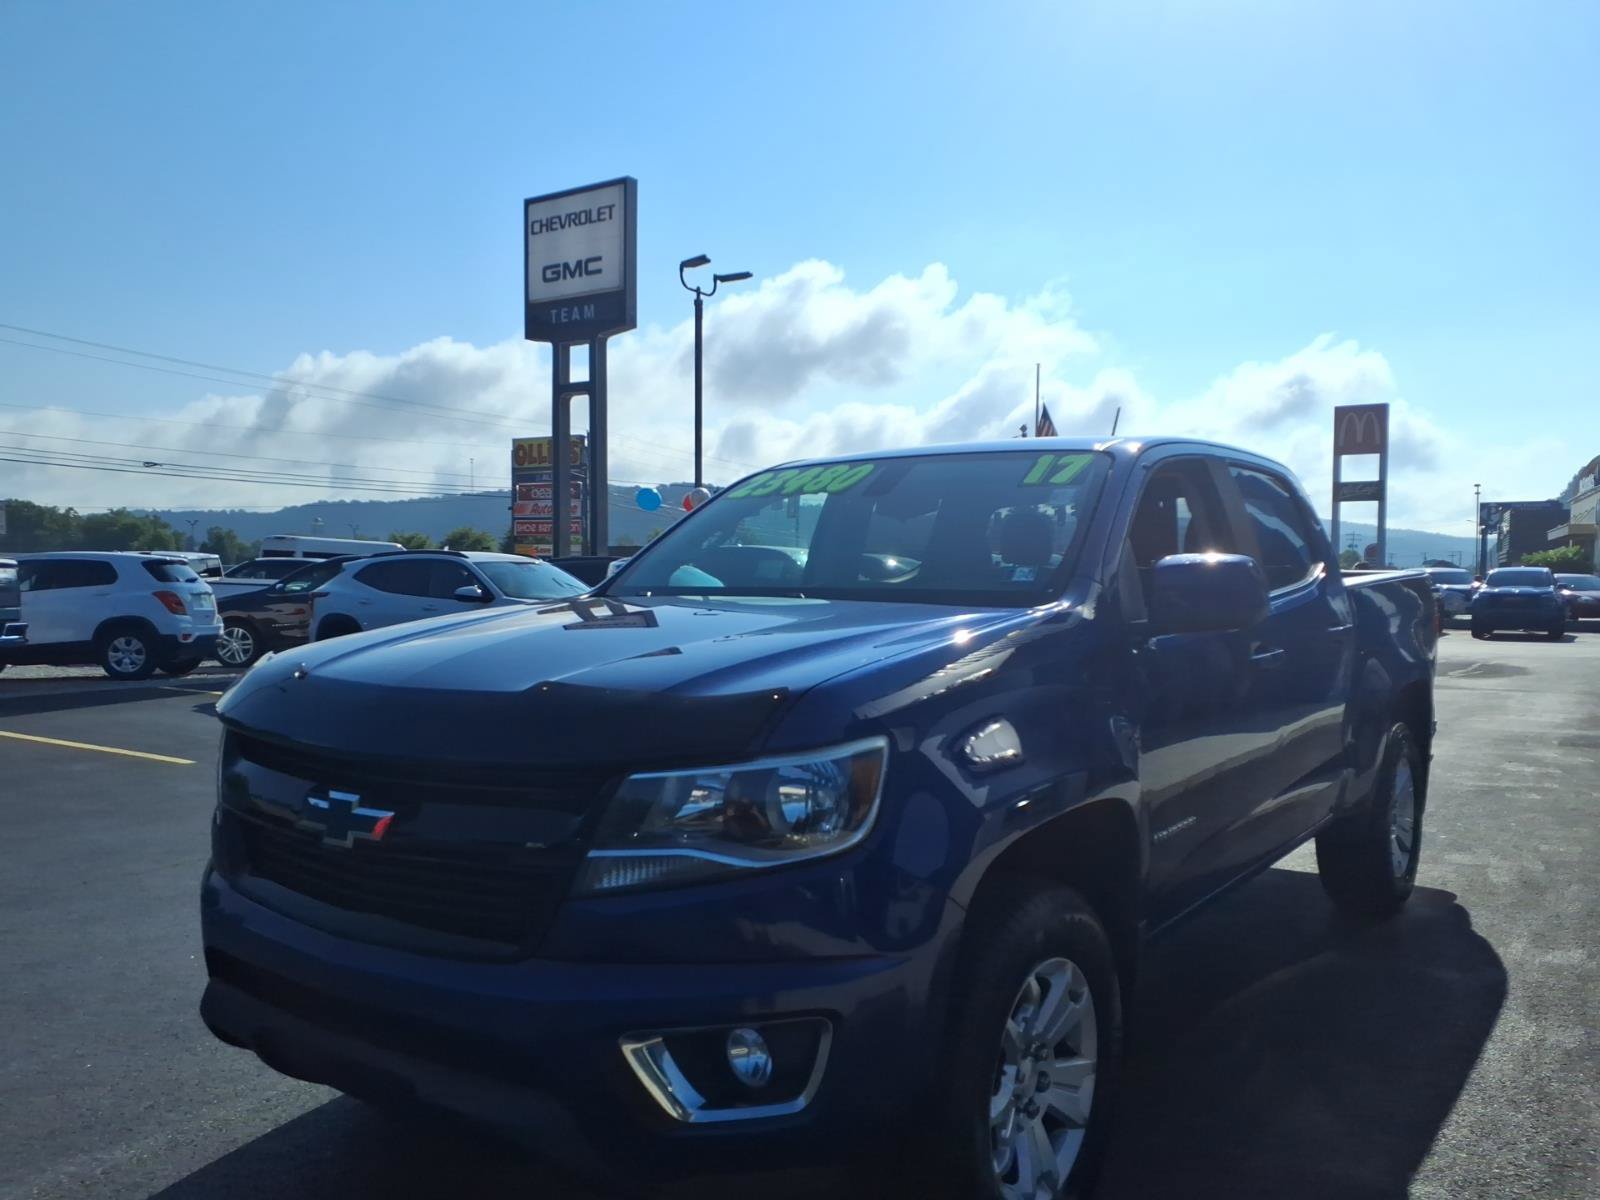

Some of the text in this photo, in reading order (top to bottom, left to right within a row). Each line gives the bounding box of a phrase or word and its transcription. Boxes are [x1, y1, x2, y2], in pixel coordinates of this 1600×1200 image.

[531, 204, 615, 236] CHEVROLET
[542, 255, 603, 283] GMC
[551, 303, 595, 325] TEAM
[1023, 454, 1093, 484] 17
